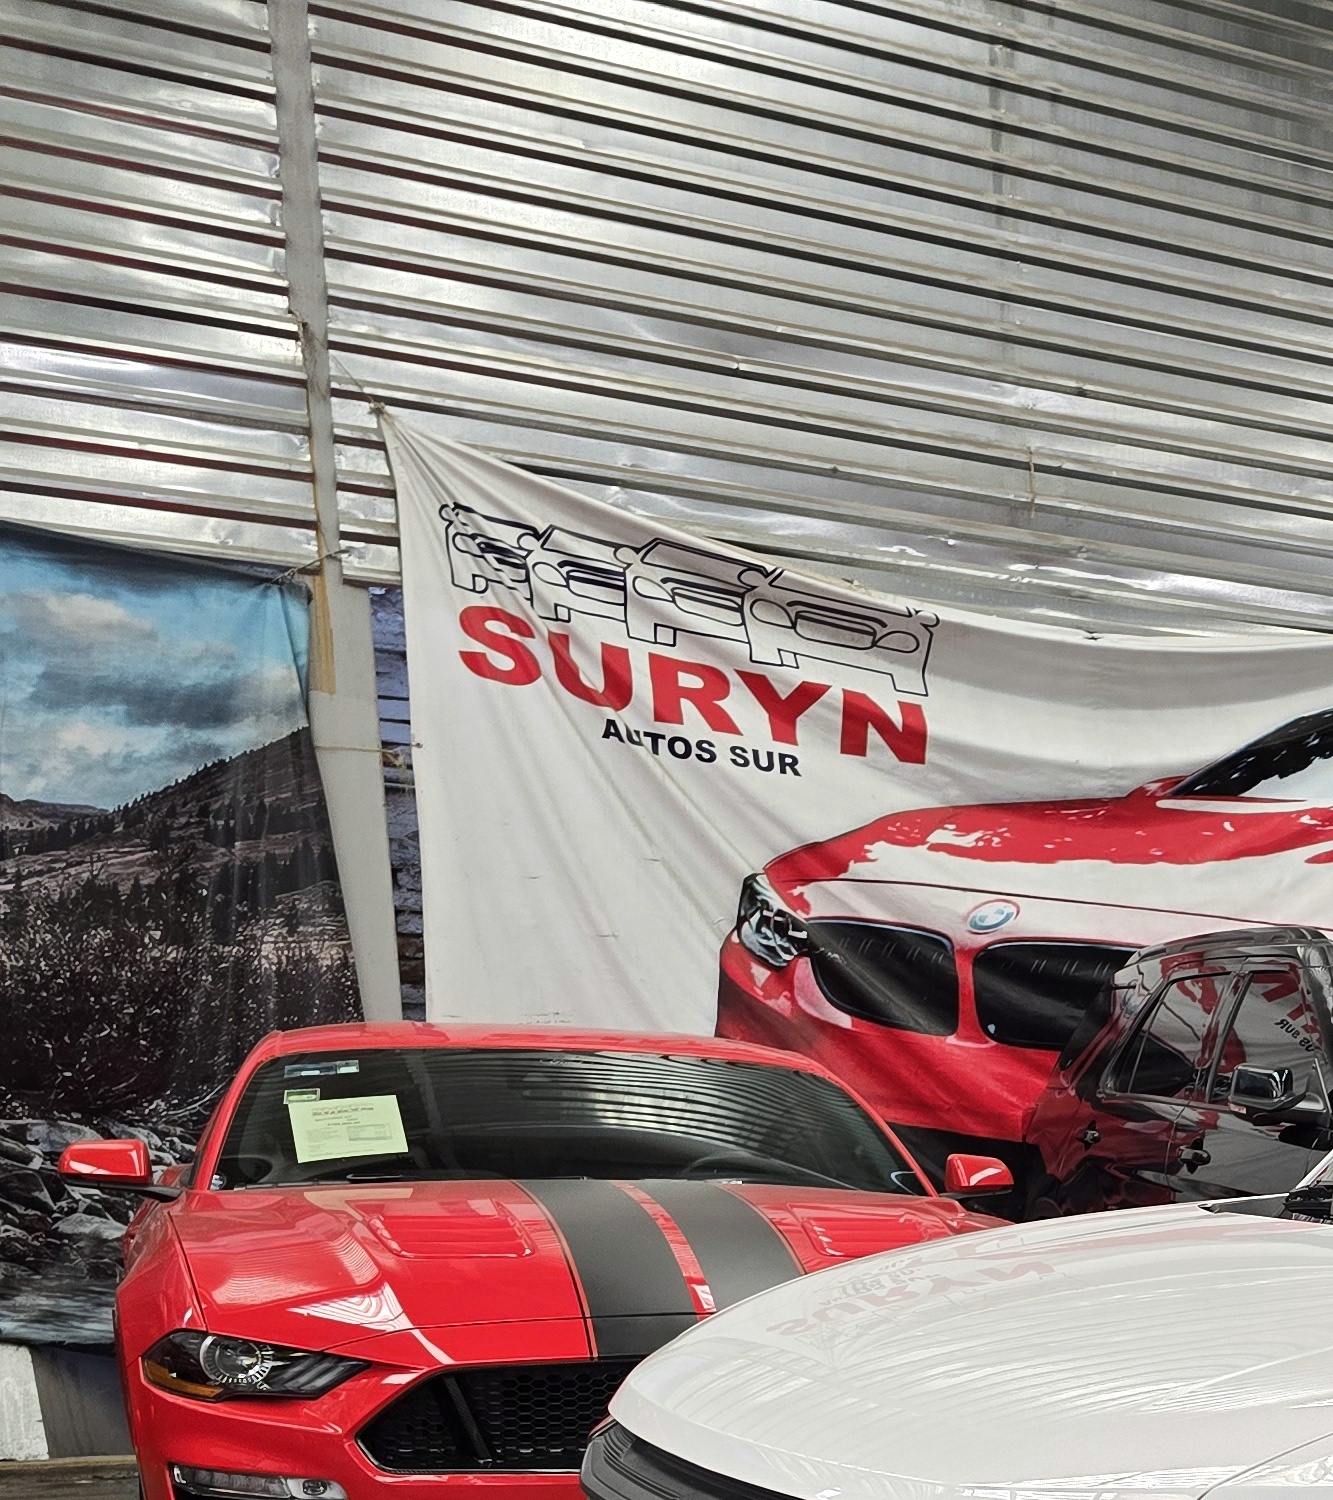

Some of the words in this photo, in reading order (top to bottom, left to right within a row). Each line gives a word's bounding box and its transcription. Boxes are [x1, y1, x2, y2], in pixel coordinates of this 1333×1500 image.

[458, 604, 928, 765] SURYN
[601, 717, 718, 764] AUTOS
[729, 744, 802, 777] SUR
